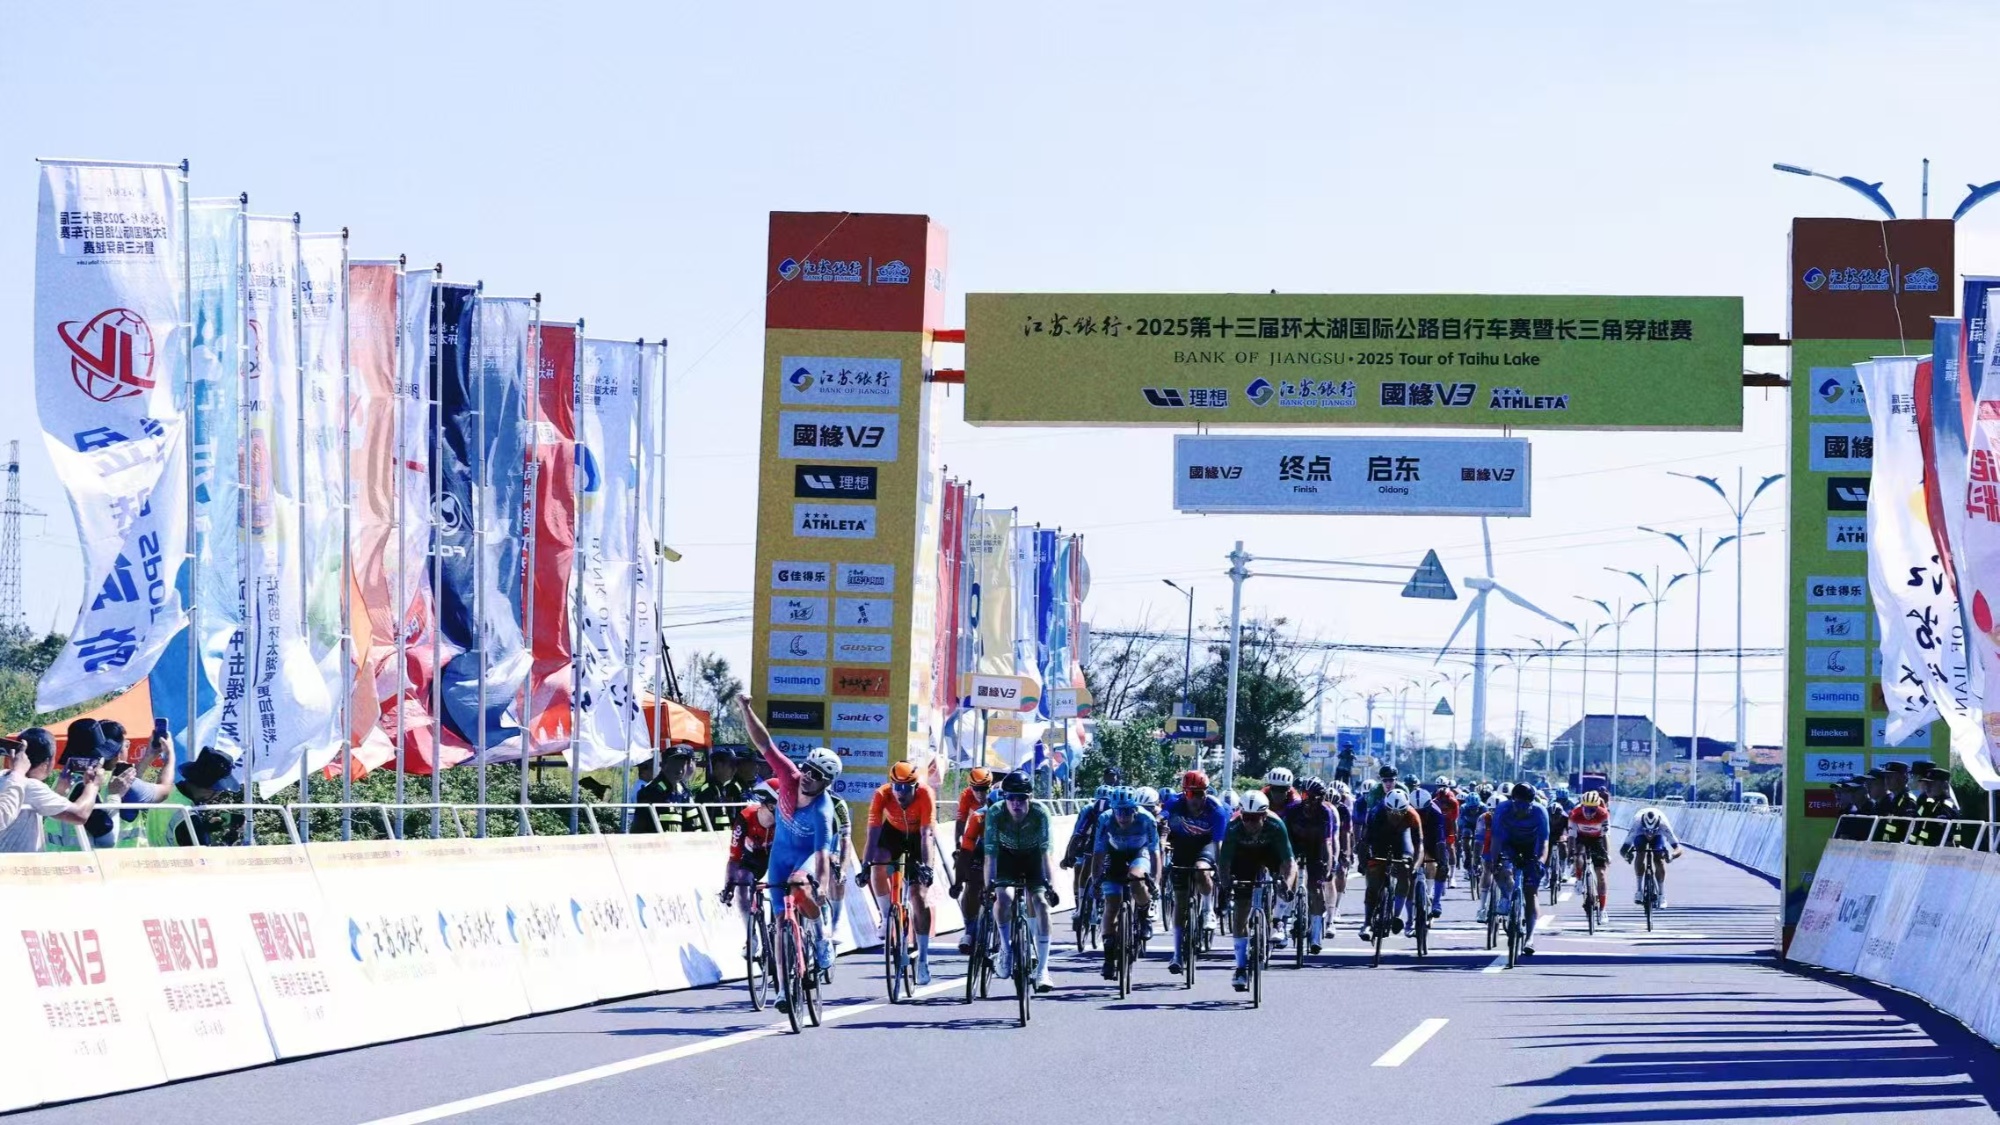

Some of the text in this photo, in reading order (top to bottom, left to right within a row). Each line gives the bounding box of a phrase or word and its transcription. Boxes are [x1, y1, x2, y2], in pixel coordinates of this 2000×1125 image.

[1174, 351, 1226, 364] BANK
[1235, 351, 1260, 364] OF
[1399, 352, 1434, 366] Tour
[1437, 352, 1458, 366] of
[1459, 352, 1500, 366] Taihu
[1504, 352, 1541, 367] Lake
[819, 369, 891, 387] 江苏银行
[1279, 378, 1358, 398] 江苏银行
[1189, 389, 1229, 408] 理想
[1381, 382, 1477, 407] 國緣V3
[1279, 398, 1357, 407] BANK OF JIANGSU
[793, 424, 885, 448] 國緣V3
[1189, 466, 1243, 480] 國緣V3
[1279, 456, 1333, 483] 终点
[1367, 456, 1420, 482] 启东
[1461, 467, 1515, 482] 國緣V3
[839, 475, 870, 490] 理想
[1293, 485, 1318, 494] Finish
[1378, 485, 1409, 495] Qidong
[802, 519, 866, 531] ATHLETA
[790, 571, 826, 582] 佳得乐
[1825, 585, 1862, 597] 佳得乐
[840, 644, 885, 652] GUSTO
[774, 676, 820, 685] SHIMANO
[977, 685, 1017, 698] 國緣V3
[1811, 692, 1860, 702] SHIMANO
[772, 711, 809, 719] Heineken
[837, 713, 872, 721] Santic
[1811, 728, 1849, 737] Heineken
